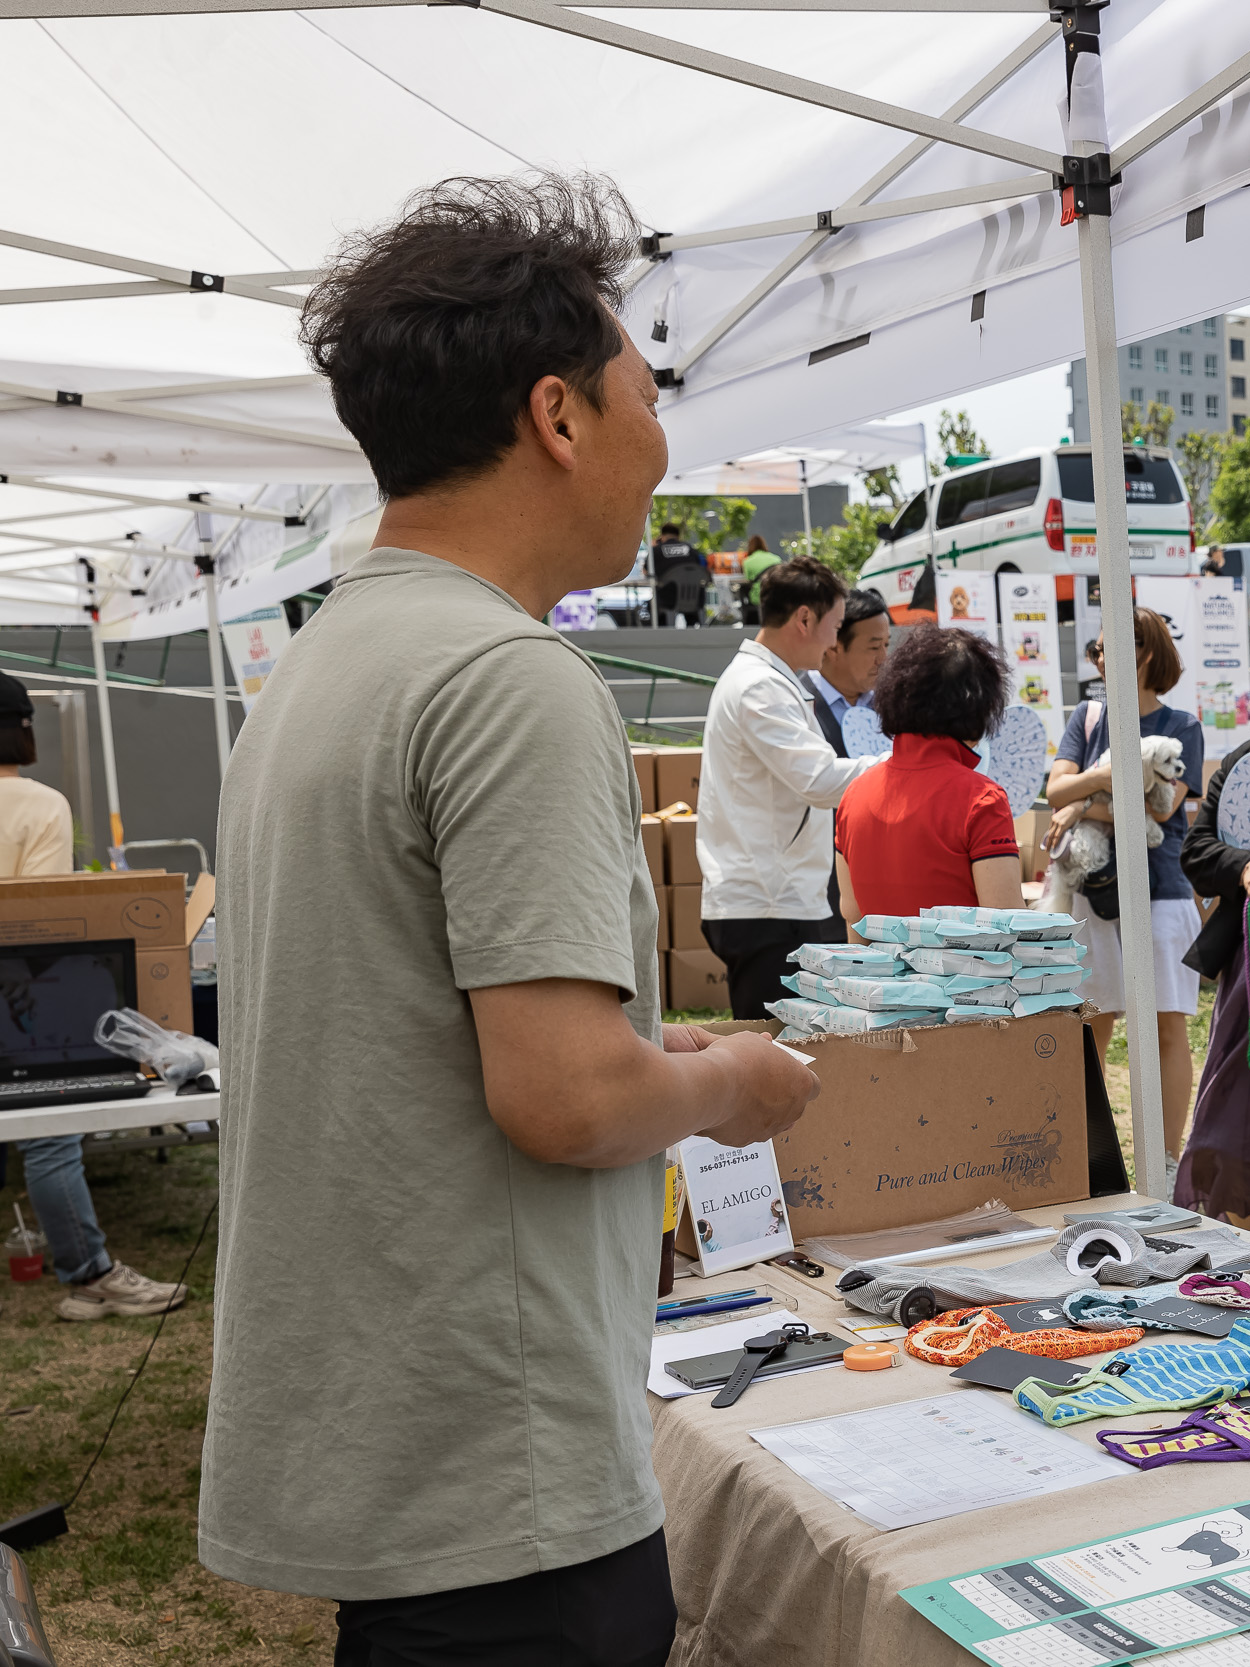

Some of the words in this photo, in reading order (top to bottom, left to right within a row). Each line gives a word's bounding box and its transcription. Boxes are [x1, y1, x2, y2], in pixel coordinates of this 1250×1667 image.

[997, 1129, 1043, 1145] Premium
[699, 1152, 759, 1173] 356-0371-6713-03
[875, 1172, 914, 1192] Pure
[918, 1164, 949, 1185] and
[953, 1162, 996, 1182] Clean
[1001, 1154, 1047, 1178] Wipes
[701, 1199, 720, 1214] EL
[721, 1185, 772, 1209] AMIGO
